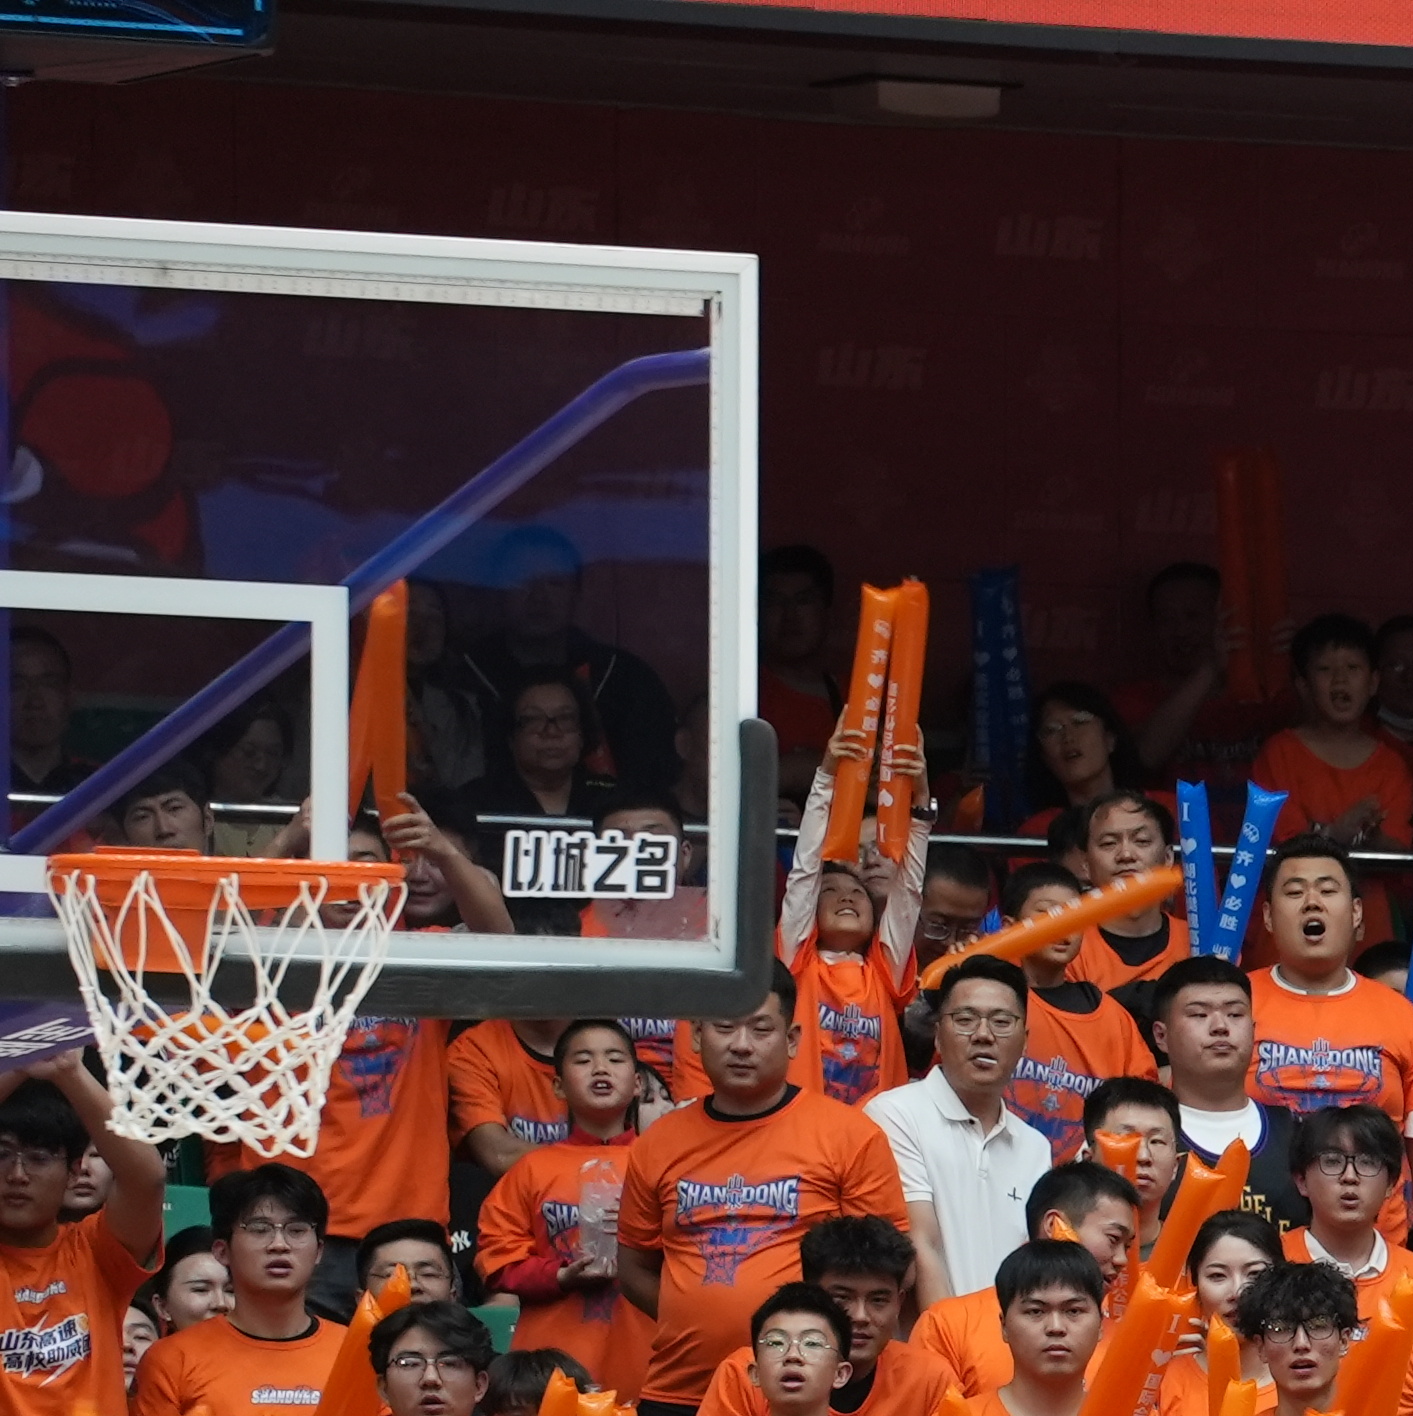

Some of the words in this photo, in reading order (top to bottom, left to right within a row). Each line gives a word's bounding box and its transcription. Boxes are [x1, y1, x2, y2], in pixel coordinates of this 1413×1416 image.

[511, 835, 670, 893] 以城之名
[1236, 851, 1255, 868] 齐
[1218, 895, 1244, 932] 必胜
[1260, 1042, 1382, 1077] SHANDONG
[677, 1176, 799, 1212] SHANDONG
